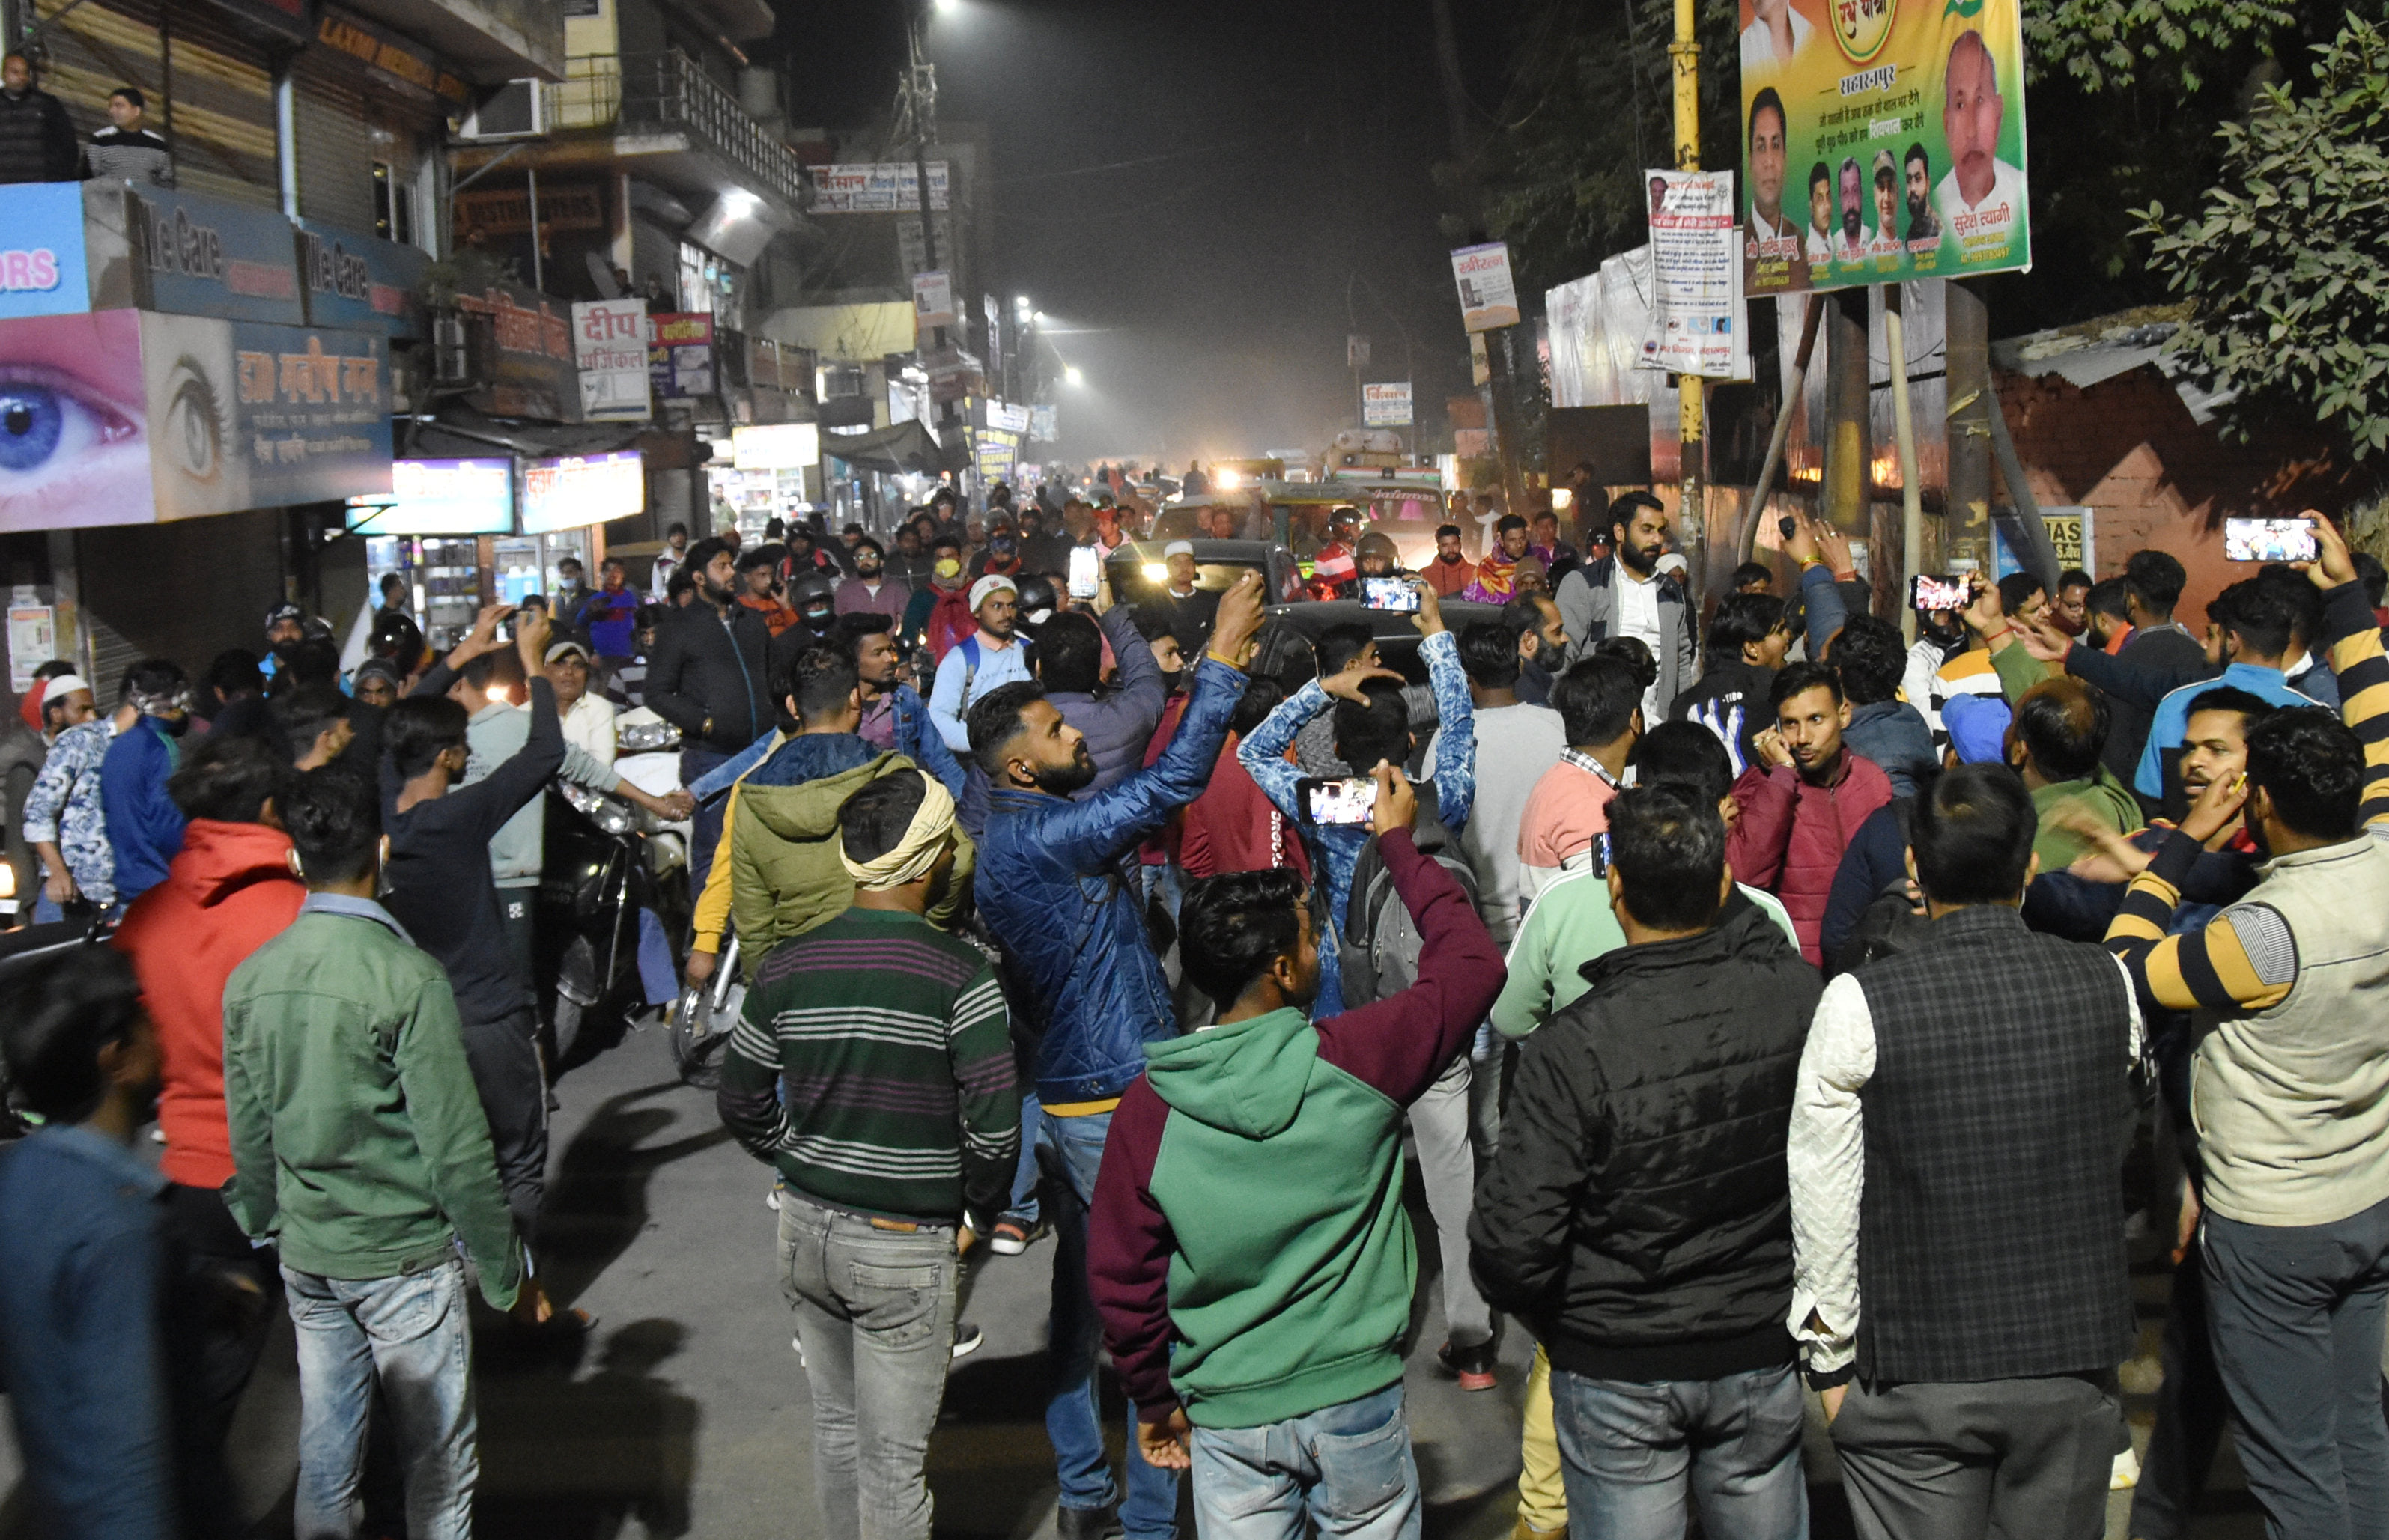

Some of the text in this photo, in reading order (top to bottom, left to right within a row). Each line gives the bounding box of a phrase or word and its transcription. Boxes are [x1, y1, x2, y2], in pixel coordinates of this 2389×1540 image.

[1839, 64, 1896, 96] सहारनपुर
[1953, 201, 2011, 237] सुरेश त्यागी
[580, 307, 639, 341] दीप
